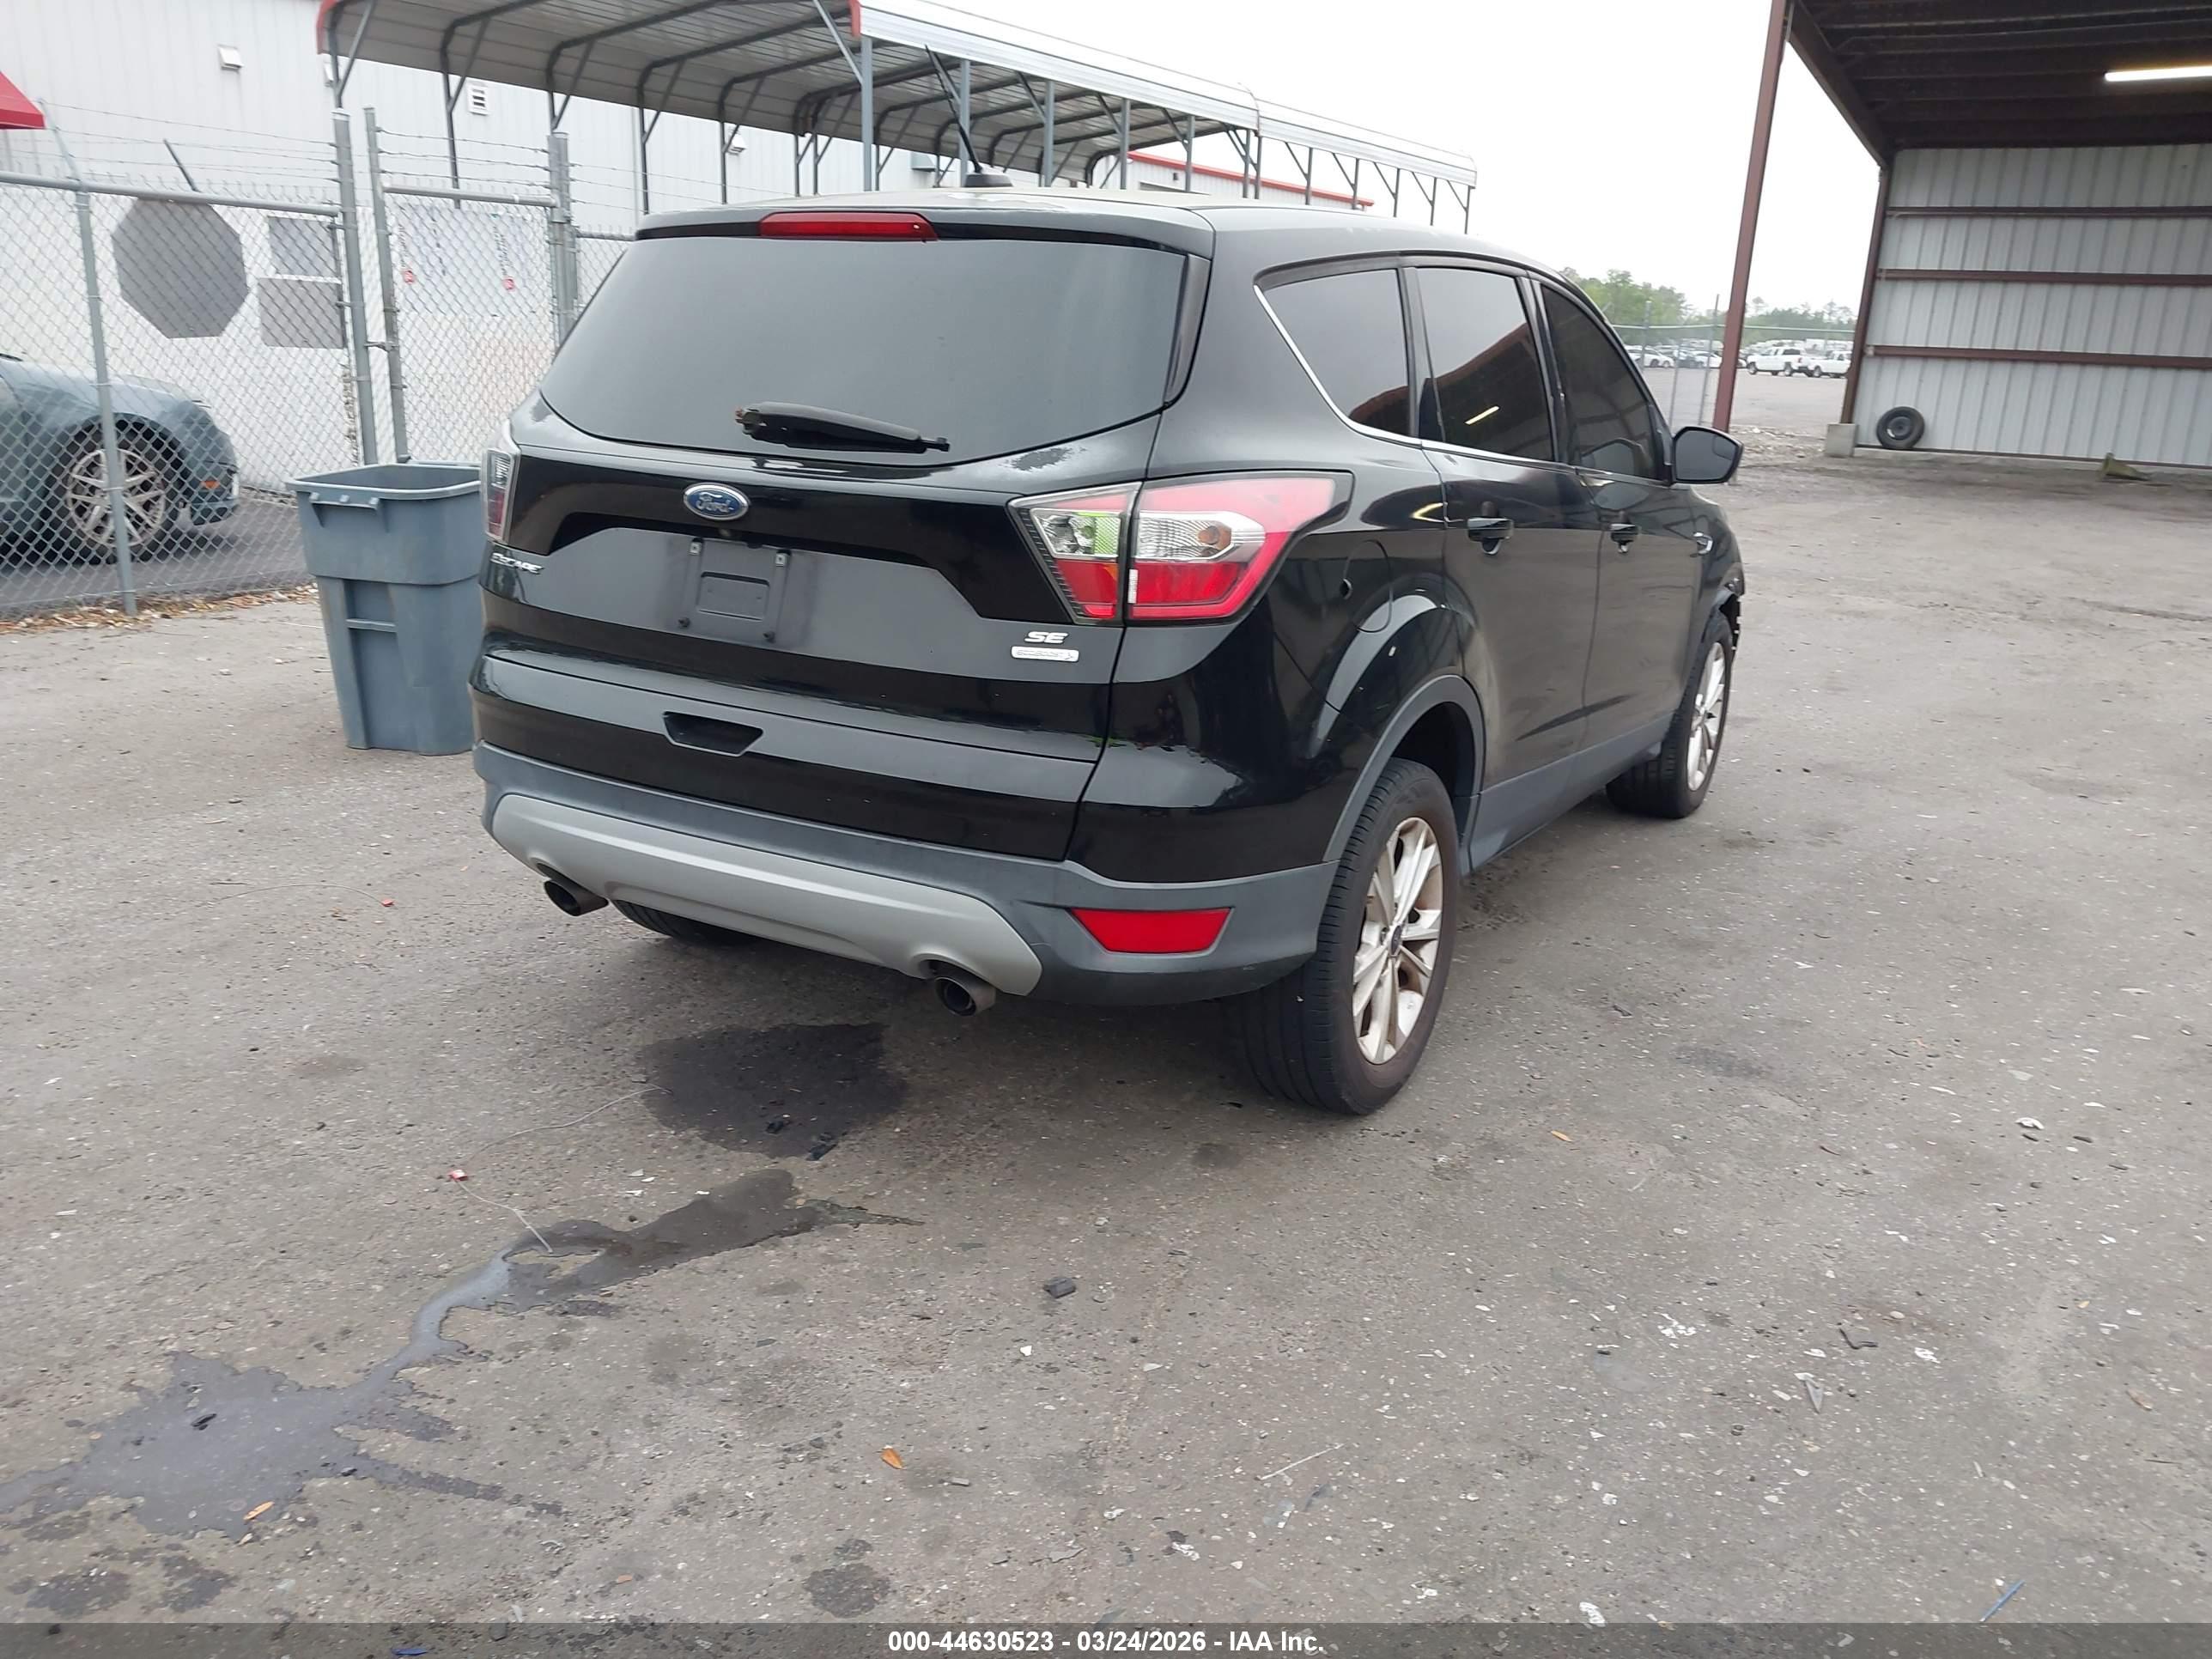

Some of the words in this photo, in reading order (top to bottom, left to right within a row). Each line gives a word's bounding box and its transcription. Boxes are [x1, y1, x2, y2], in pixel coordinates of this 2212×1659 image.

[696, 491, 735, 513] Ford
[489, 551, 544, 574] ESCAPE
[1024, 631, 1069, 643] SE
